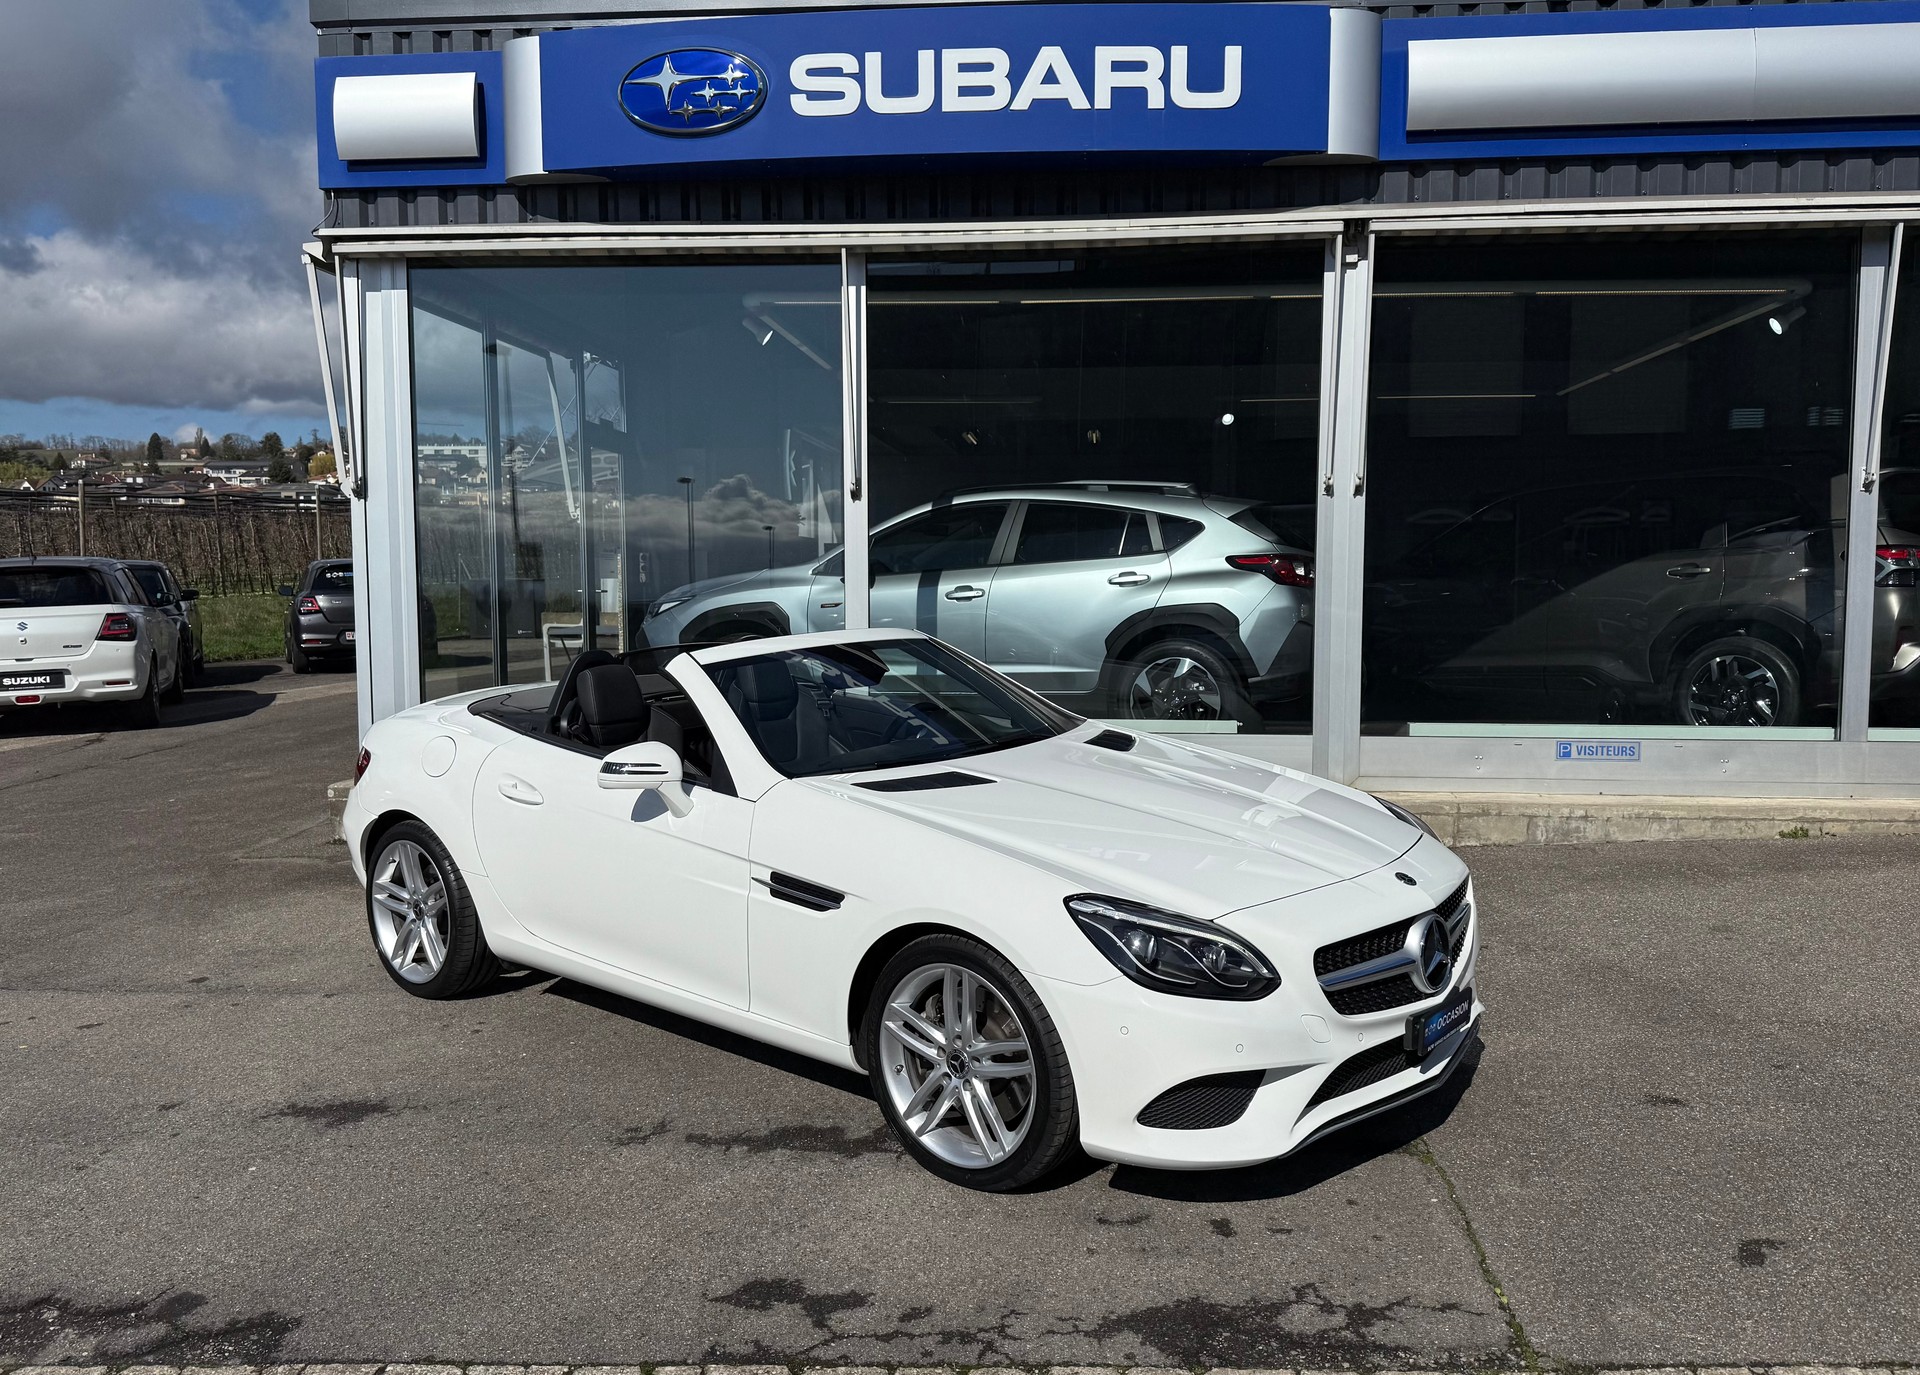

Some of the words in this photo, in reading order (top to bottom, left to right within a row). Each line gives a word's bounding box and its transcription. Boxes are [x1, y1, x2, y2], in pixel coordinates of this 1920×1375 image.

[789, 45, 1242, 117] SUBARU
[2, 675, 50, 686] SUZUKI
[1559, 743, 1571, 757] P
[1576, 745, 1635, 757] VISITEURS
[1437, 1000, 1469, 1030] OCCASION
